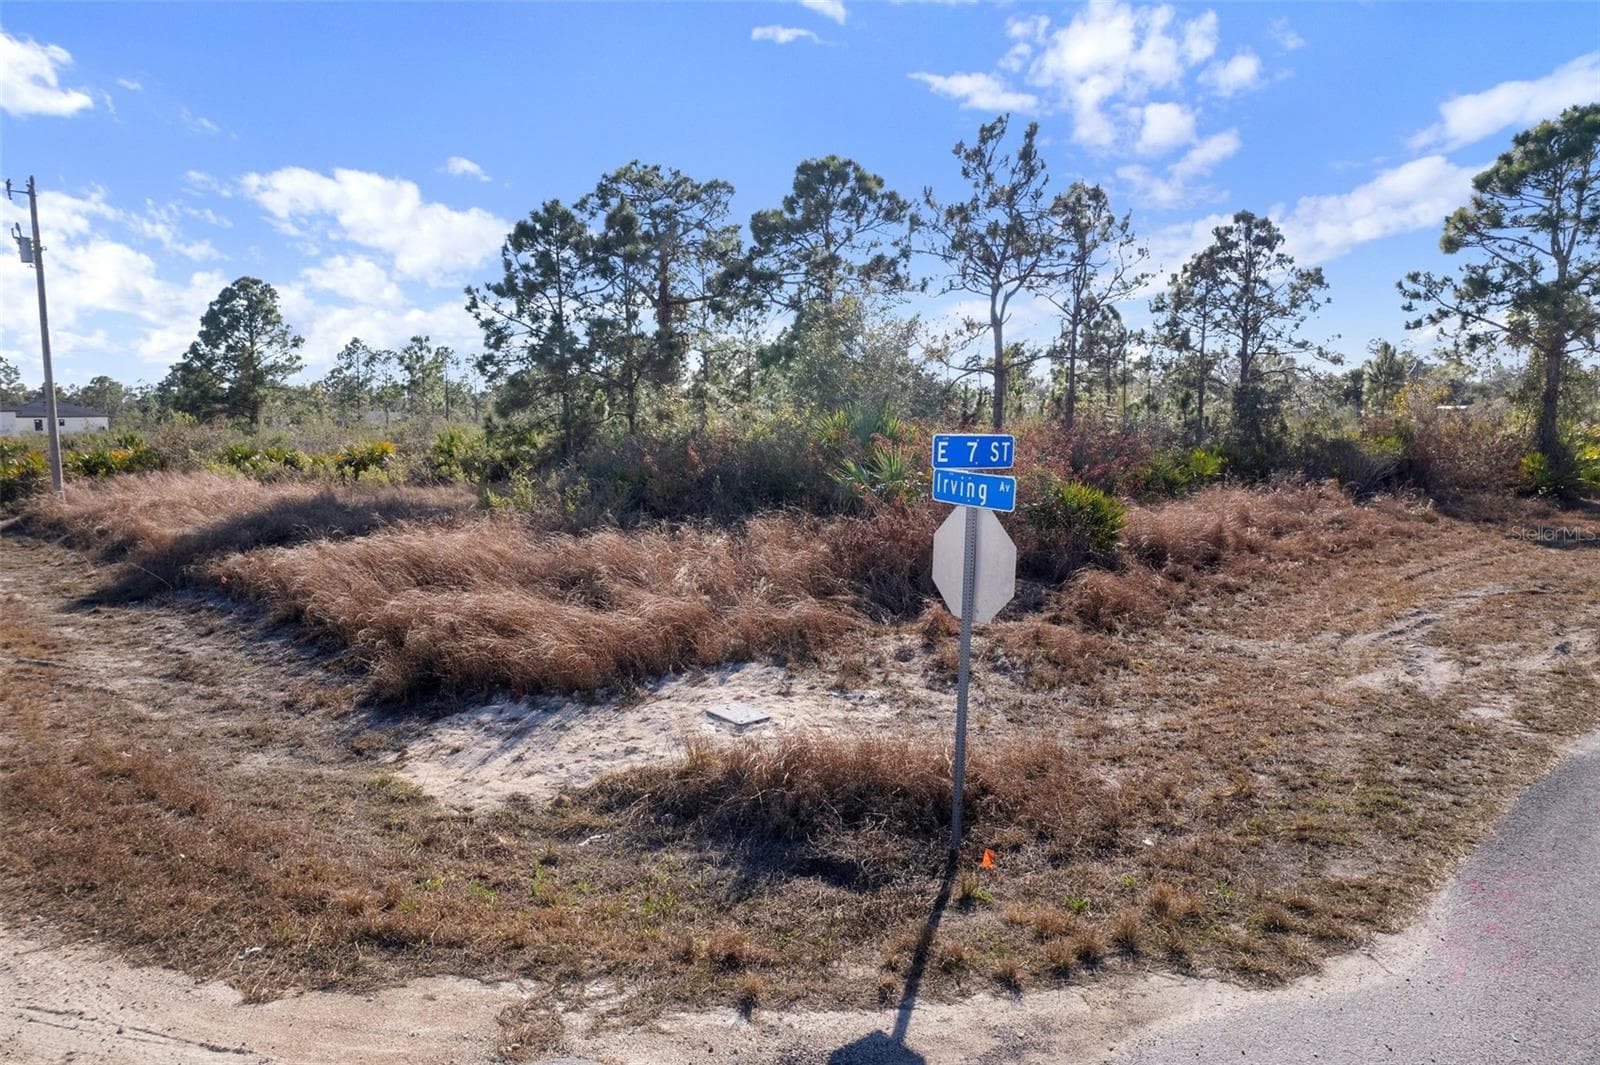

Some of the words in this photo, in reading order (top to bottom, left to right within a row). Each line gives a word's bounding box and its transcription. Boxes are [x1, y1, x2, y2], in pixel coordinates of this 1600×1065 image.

[937, 442, 948, 462] E
[967, 442, 977, 462] 7
[990, 442, 1010, 462] ST
[937, 473, 988, 505] Irving
